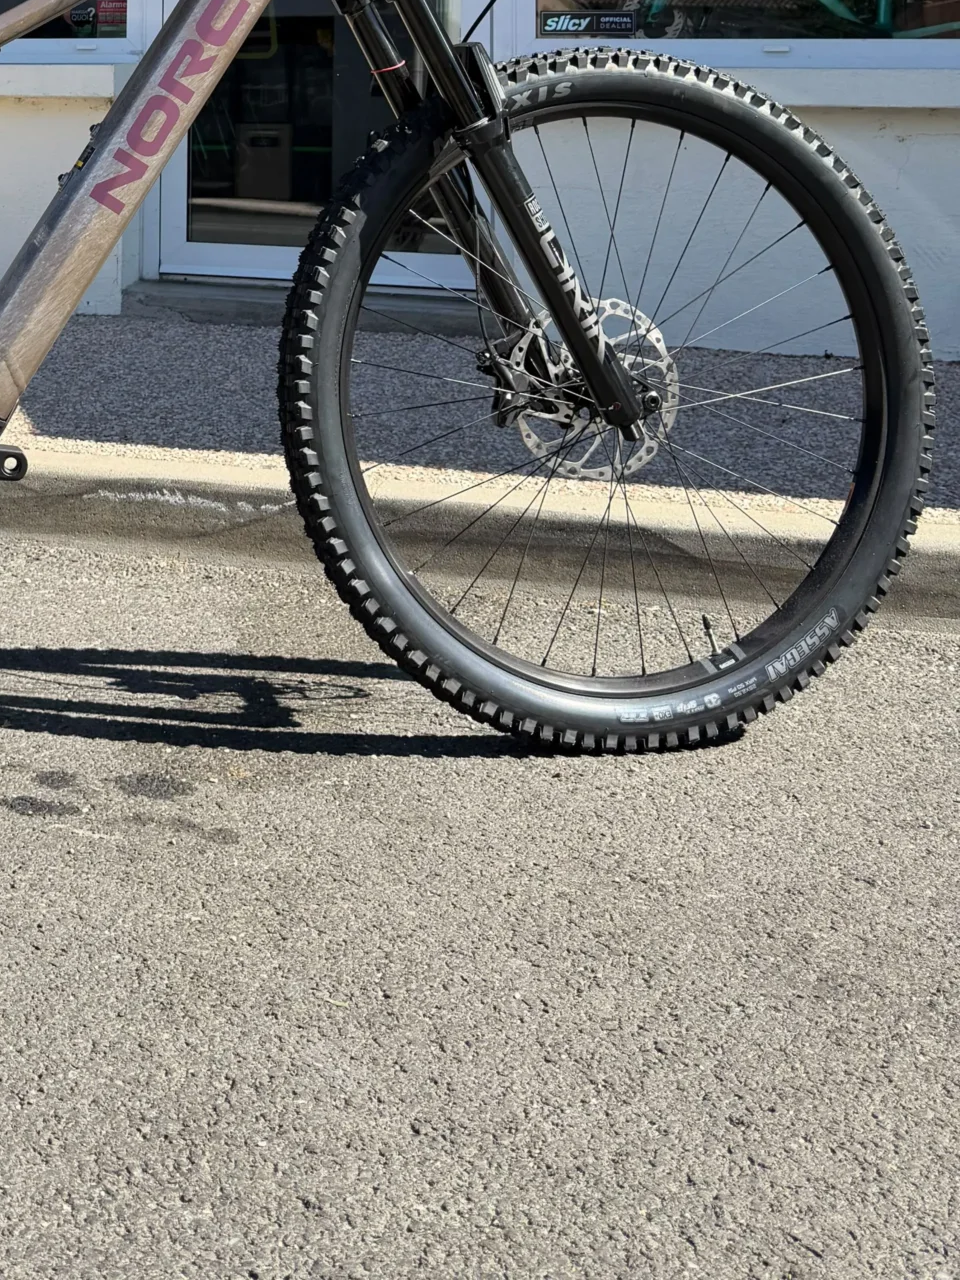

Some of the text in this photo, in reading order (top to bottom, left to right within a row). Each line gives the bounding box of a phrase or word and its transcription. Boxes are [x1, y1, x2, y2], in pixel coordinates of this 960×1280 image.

[544, 15, 591, 31] slicy
[509, 81, 575, 112] XIS
[765, 608, 840, 683] ASSEGAI
